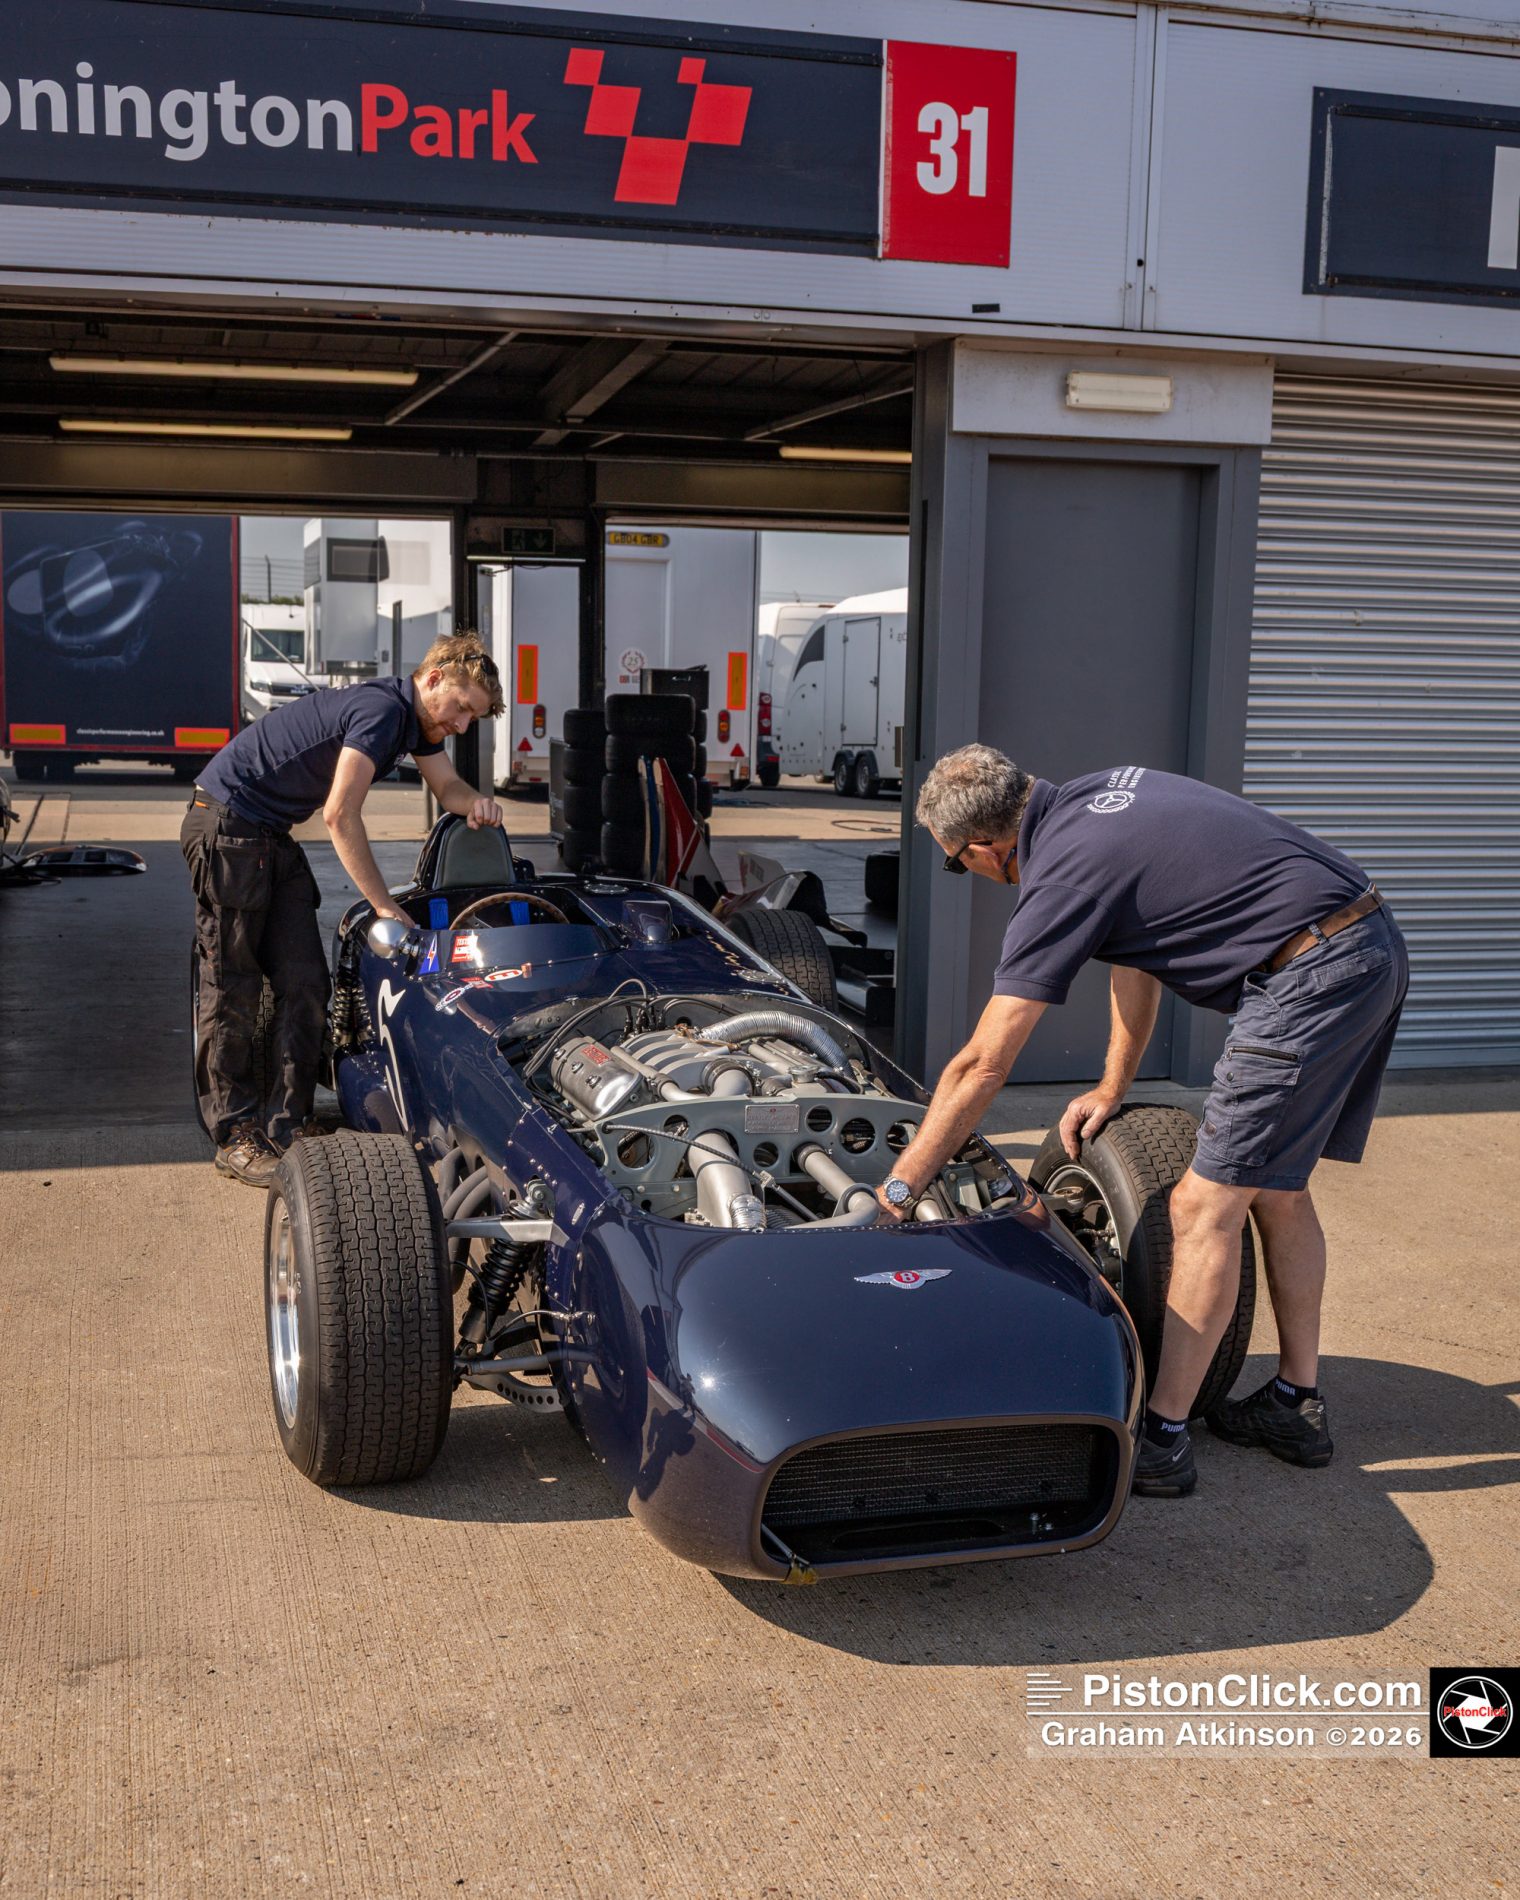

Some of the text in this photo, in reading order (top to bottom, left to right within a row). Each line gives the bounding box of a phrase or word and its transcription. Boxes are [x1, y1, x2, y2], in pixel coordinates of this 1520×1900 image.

[0, 61, 539, 164] ningtonPark
[916, 102, 988, 197] 31
[900, 1272, 916, 1282] B
[1275, 1378, 1296, 1396] PUMA
[1161, 1422, 1185, 1433] PUMA
